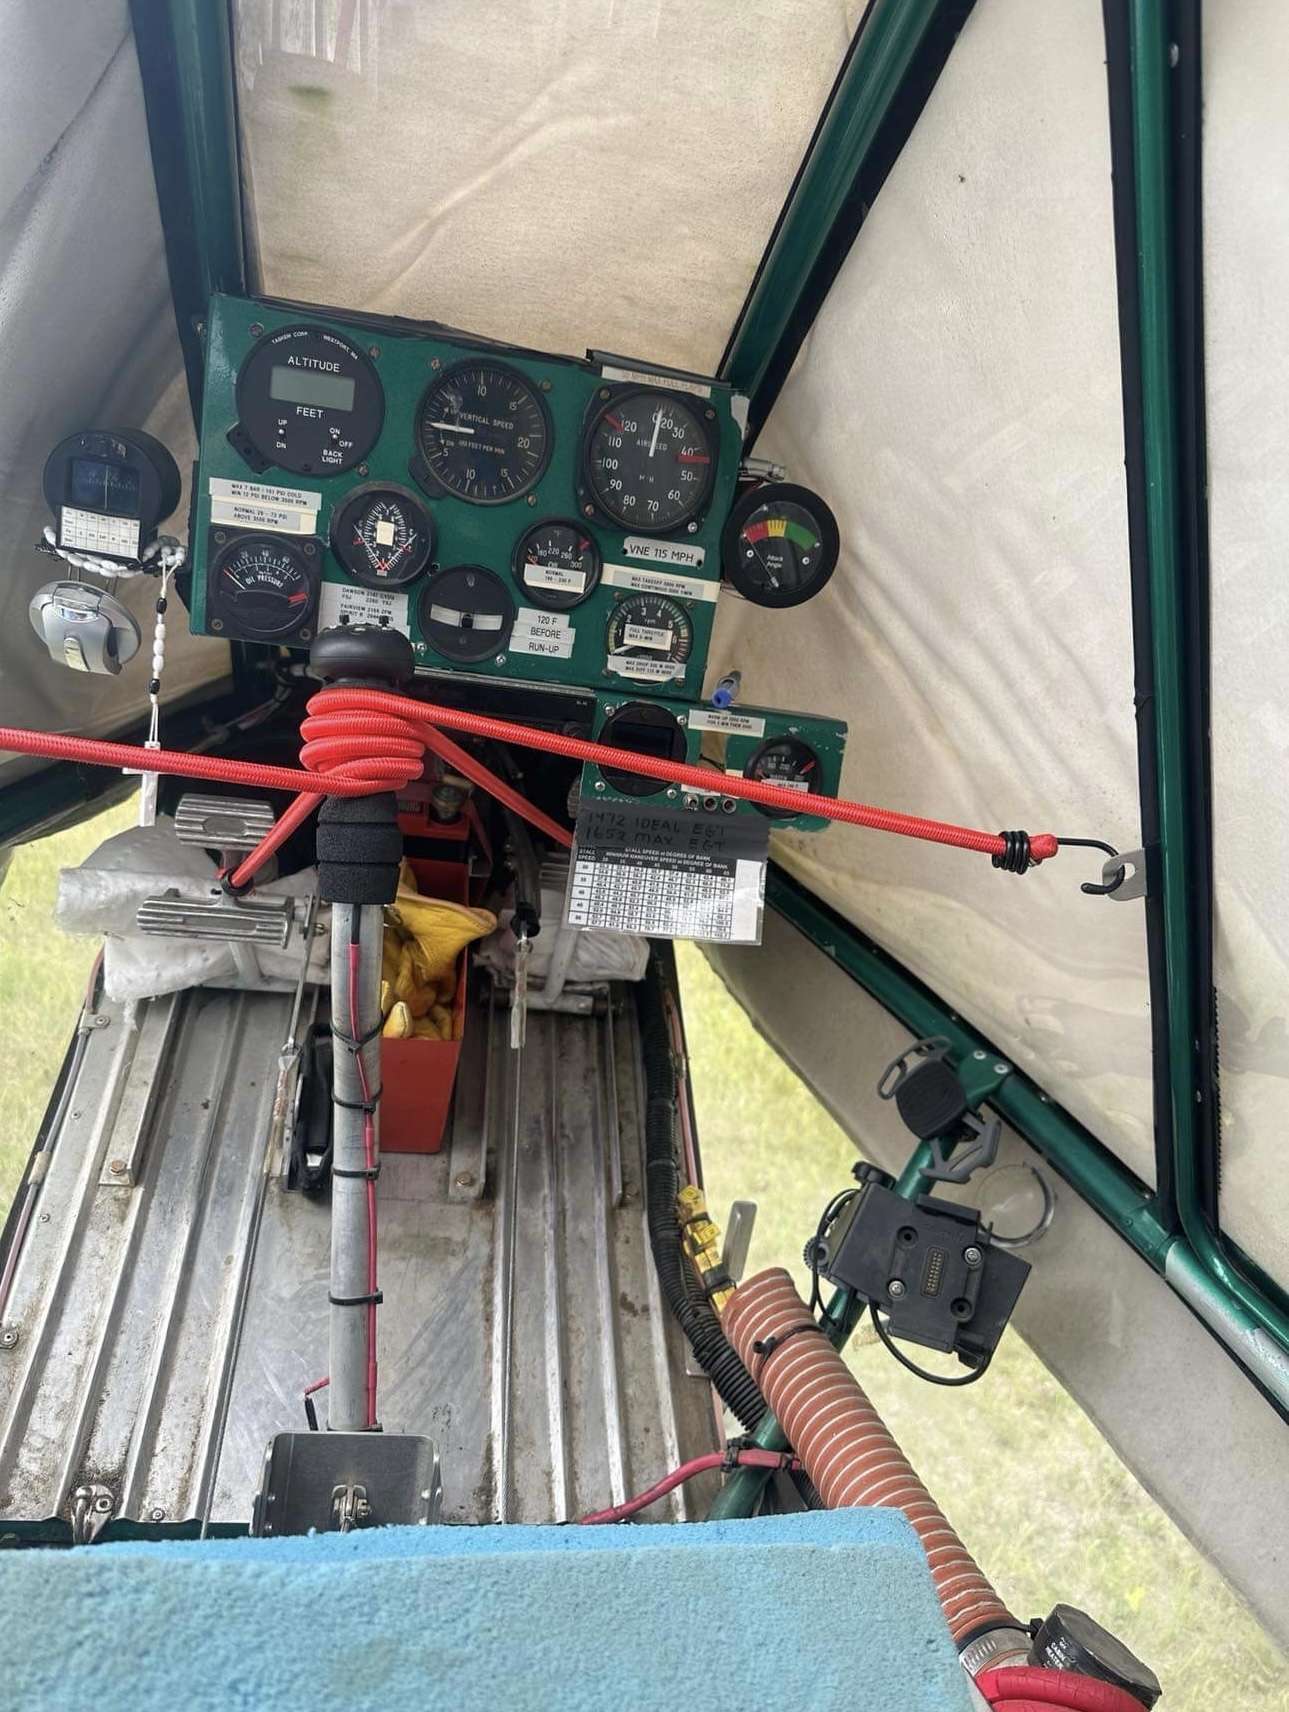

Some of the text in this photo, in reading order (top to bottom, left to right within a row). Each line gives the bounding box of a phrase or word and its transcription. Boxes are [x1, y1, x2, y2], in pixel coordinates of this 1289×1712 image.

[287, 356, 341, 373] ALTITUDE
[477, 385, 487, 397] 10
[509, 401, 517, 411] 15
[296, 406, 324, 419] FEET
[460, 412, 514, 430] VERTICAL SPEED
[660, 418, 673, 430] 20
[672, 427, 685, 439] 30
[517, 437, 530, 449] 20
[608, 435, 622, 448] 110
[442, 449, 449, 457] 5
[681, 447, 694, 457] 40
[322, 456, 343, 465] LIGHT
[602, 457, 618, 470] 100
[465, 468, 476, 480] 10
[500, 468, 508, 478] 15
[680, 470, 693, 481] 50
[609, 479, 622, 490] 90
[261, 494, 279, 502] BELOW
[623, 495, 636, 506] 80
[667, 489, 680, 501] 60
[234, 506, 255, 514] NORMAL
[647, 500, 659, 512] 70
[233, 513, 251, 521] ABOVE
[548, 547, 560, 555] 220
[570, 561, 582, 569] 300
[629, 544, 694, 563] VNE 115 MPH
[245, 574, 284, 588] OIL PRESSURE
[342, 587, 365, 596] DAWSON
[340, 604, 366, 612] FAIRVIEW
[641, 608, 646, 616] 3
[626, 614, 632, 623] 2
[656, 610, 662, 618] 4
[537, 615, 558, 625] 120 F
[668, 620, 673, 629] 5
[530, 627, 561, 639] BEFORE
[528, 642, 559, 654] RUN-UP
[588, 812, 725, 838] 1472 IDEAL EGT
[634, 832, 673, 846] MAX
[688, 837, 727, 852] EGT
[659, 856, 677, 864] SPEED
